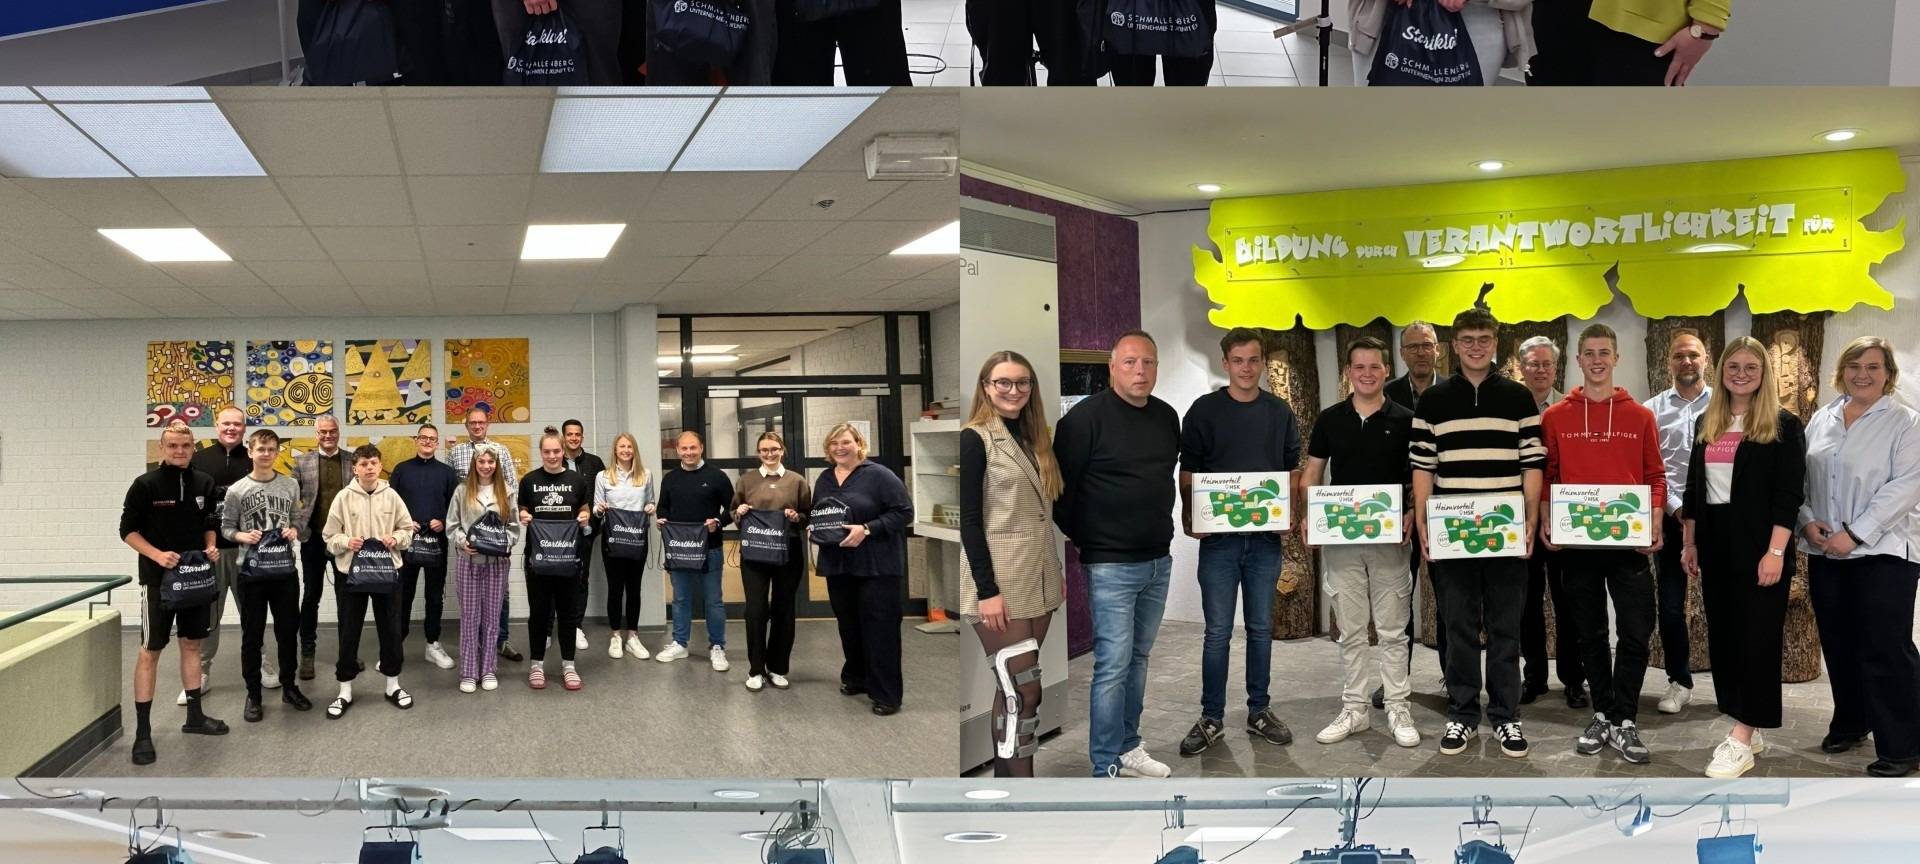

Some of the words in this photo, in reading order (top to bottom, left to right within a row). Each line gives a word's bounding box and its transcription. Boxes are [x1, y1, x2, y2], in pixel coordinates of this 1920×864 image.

[1803, 215, 1834, 235] FÜR
[533, 484, 573, 492] Landwirt
[669, 540, 704, 548] Startklar!
